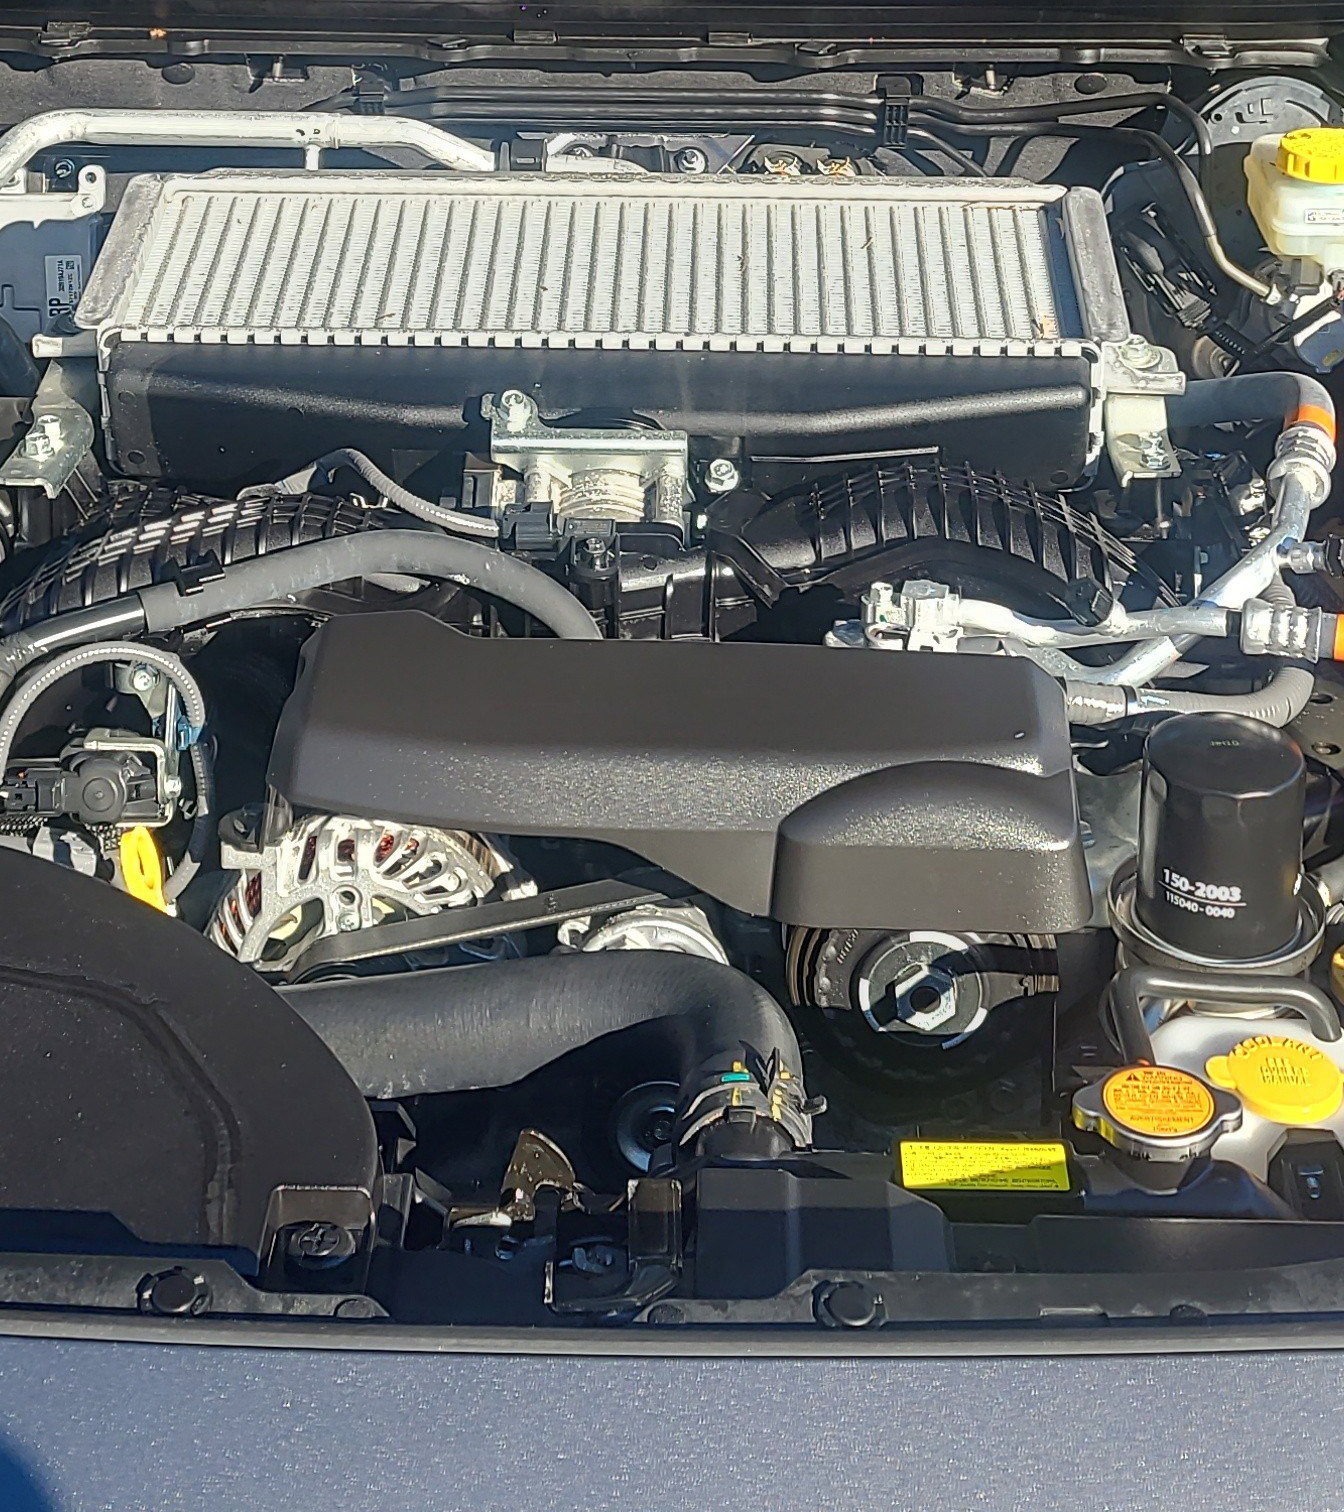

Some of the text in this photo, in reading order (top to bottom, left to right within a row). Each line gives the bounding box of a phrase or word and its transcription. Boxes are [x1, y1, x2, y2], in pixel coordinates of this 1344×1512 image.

[1163, 868, 1242, 902] 150-2003
[1165, 891, 1235, 918] 115040-0040
[1229, 1034, 1325, 1060] COOLANT
